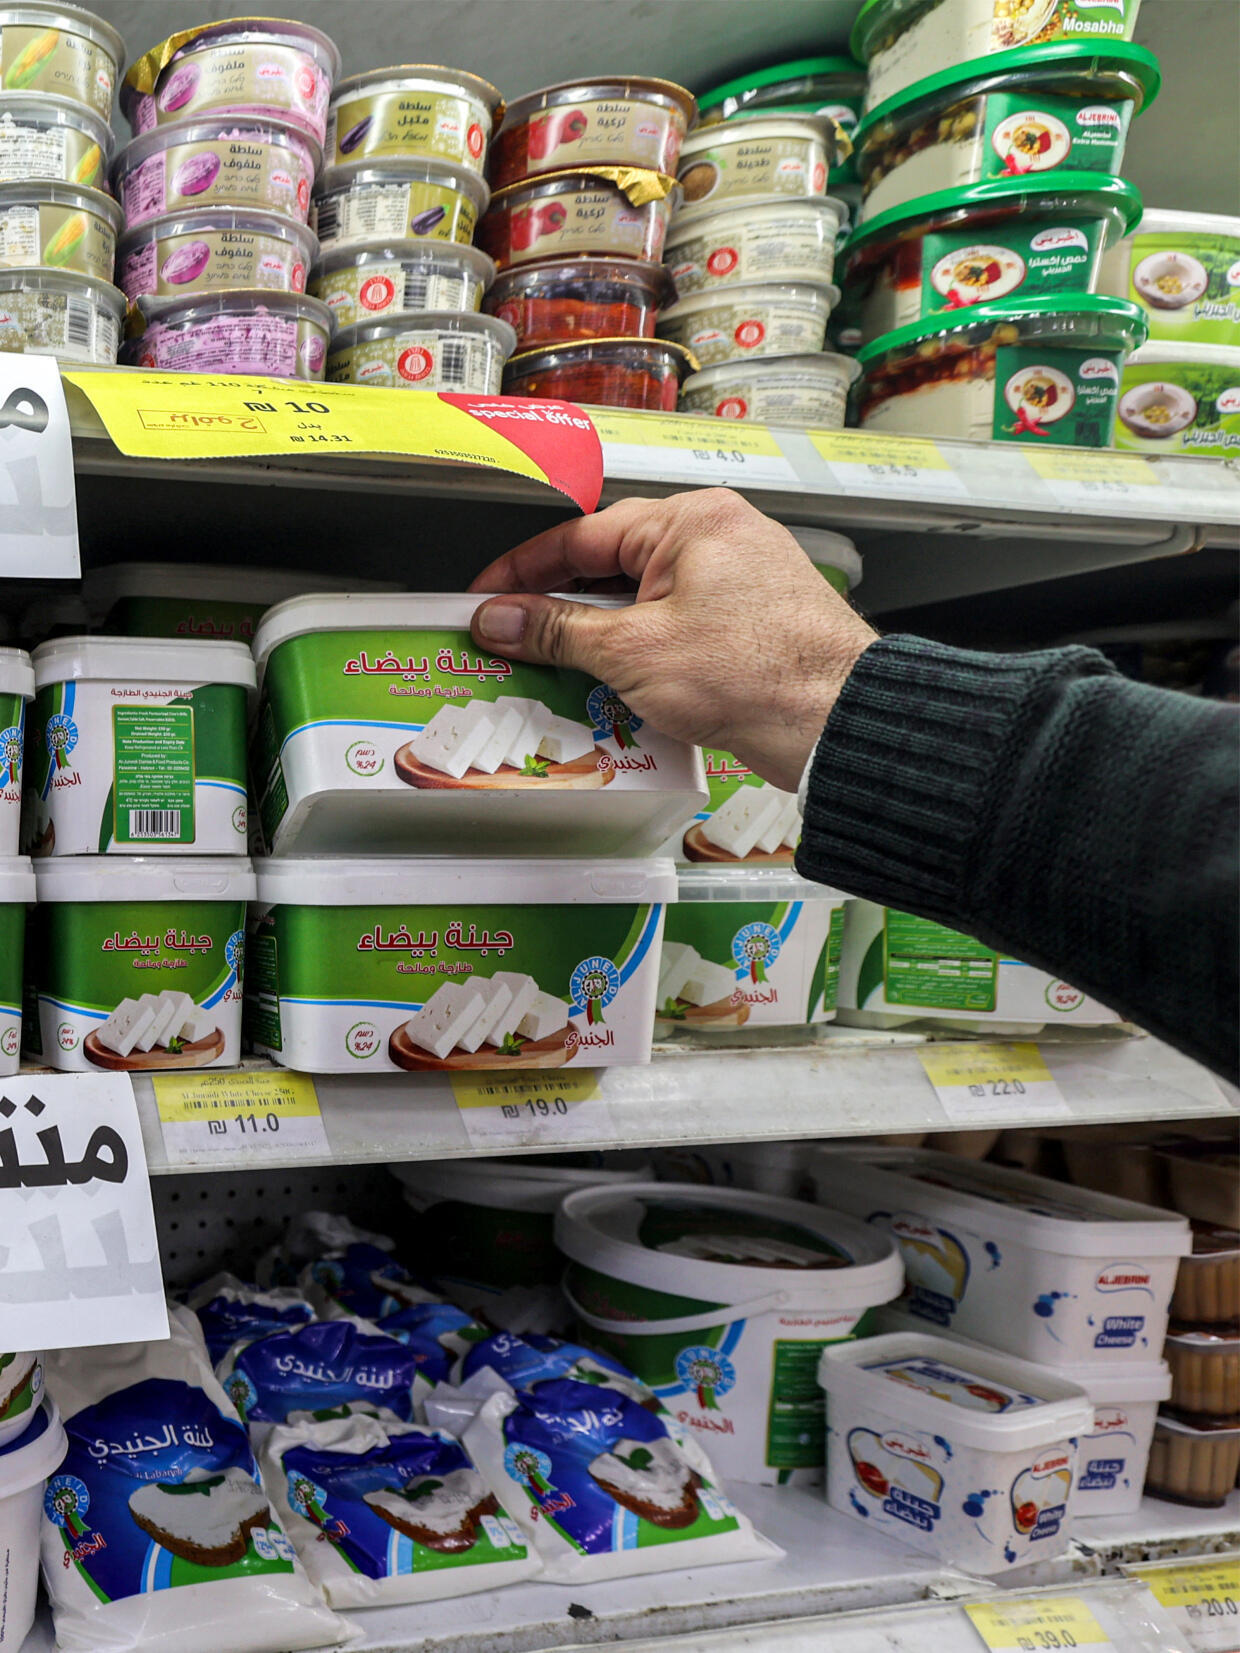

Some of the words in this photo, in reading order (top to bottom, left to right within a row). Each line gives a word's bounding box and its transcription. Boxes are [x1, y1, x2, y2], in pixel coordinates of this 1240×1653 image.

[1062, 18, 1124, 34] Mosabha
[284, 401, 330, 414] 10
[468, 407, 544, 423] special
[544, 410, 591, 431] offer
[310, 434, 353, 443] 14.31
[714, 449, 745, 464] 4.0
[342, 650, 430, 681] بيضاء
[436, 648, 513, 682] جبنة
[388, 683, 433, 698] ومالحة
[434, 684, 473, 698] طازجة
[597, 754, 658, 773] الجنيدي
[102, 931, 162, 954] بيضاء
[164, 929, 213, 955] جبنة
[357, 924, 438, 957] بيضاء
[445, 920, 514, 956] جبنة
[396, 960, 436, 975] ومالحة
[438, 960, 473, 973] طازجة
[729, 985, 779, 1005] الجنيدي
[564, 1028, 615, 1049] الجنيدي
[987, 1079, 1026, 1096] 22.0
[524, 1096, 568, 1118] 19.0
[234, 1112, 280, 1134] 11.0
[1105, 1317, 1143, 1331] White
[275, 1354, 354, 1386] الجنيدي
[355, 1366, 394, 1394] لبنة
[87, 1424, 179, 1465] الجنيدي
[183, 1424, 214, 1453] لبنة
[1201, 1597, 1239, 1617] 20.0
[1036, 1629, 1078, 1650] 39.0
